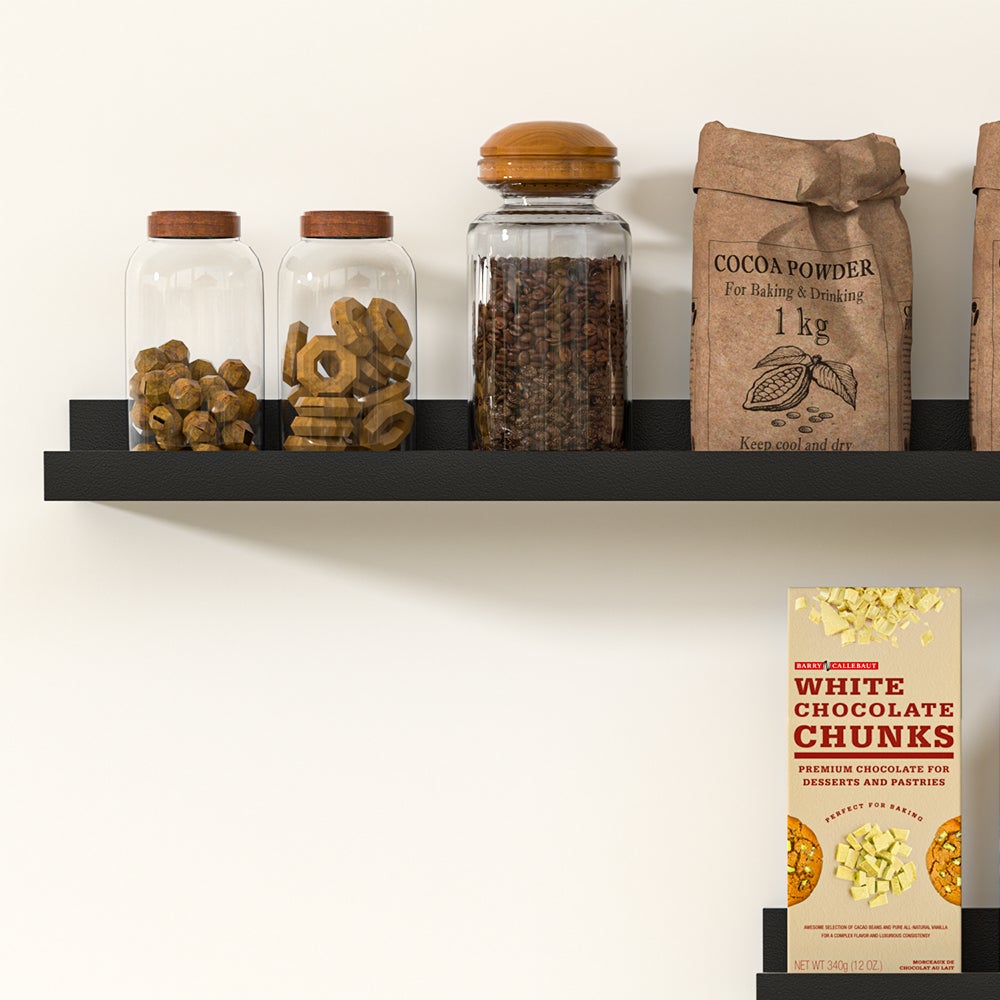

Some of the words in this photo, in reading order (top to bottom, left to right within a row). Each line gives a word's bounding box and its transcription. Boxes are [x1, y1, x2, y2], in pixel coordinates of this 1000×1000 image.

[714, 254, 782, 274] COCOA
[787, 258, 875, 281] POWDER
[725, 282, 747, 296] For
[751, 282, 793, 300] Baking
[797, 285, 807, 298] &
[810, 287, 864, 304] Drinking
[776, 306, 785, 335] 1
[796, 306, 830, 346] kg
[740, 436, 772, 451] Keep
[776, 437, 802, 450] cool
[805, 438, 828, 450] and
[832, 438, 853, 451] dry
[794, 678, 904, 695] WHITE
[794, 702, 954, 718] CHOCOLATE
[793, 725, 954, 748] CHUNKS
[798, 765, 853, 773] PREMIUM
[856, 765, 924, 773] CHOCOLATE
[928, 765, 950, 773] FOR
[803, 778, 860, 786] DESSERTS
[863, 778, 888, 786] AND
[891, 778, 945, 786] PASTRIES
[825, 804, 864, 823] PERFECT
[890, 804, 924, 822] BAKING
[794, 960, 810, 971] NET
[812, 960, 825, 971] WT
[827, 960, 848, 973] 340g
[850, 960, 864, 972] (12
[866, 960, 883, 972] OZ.)
